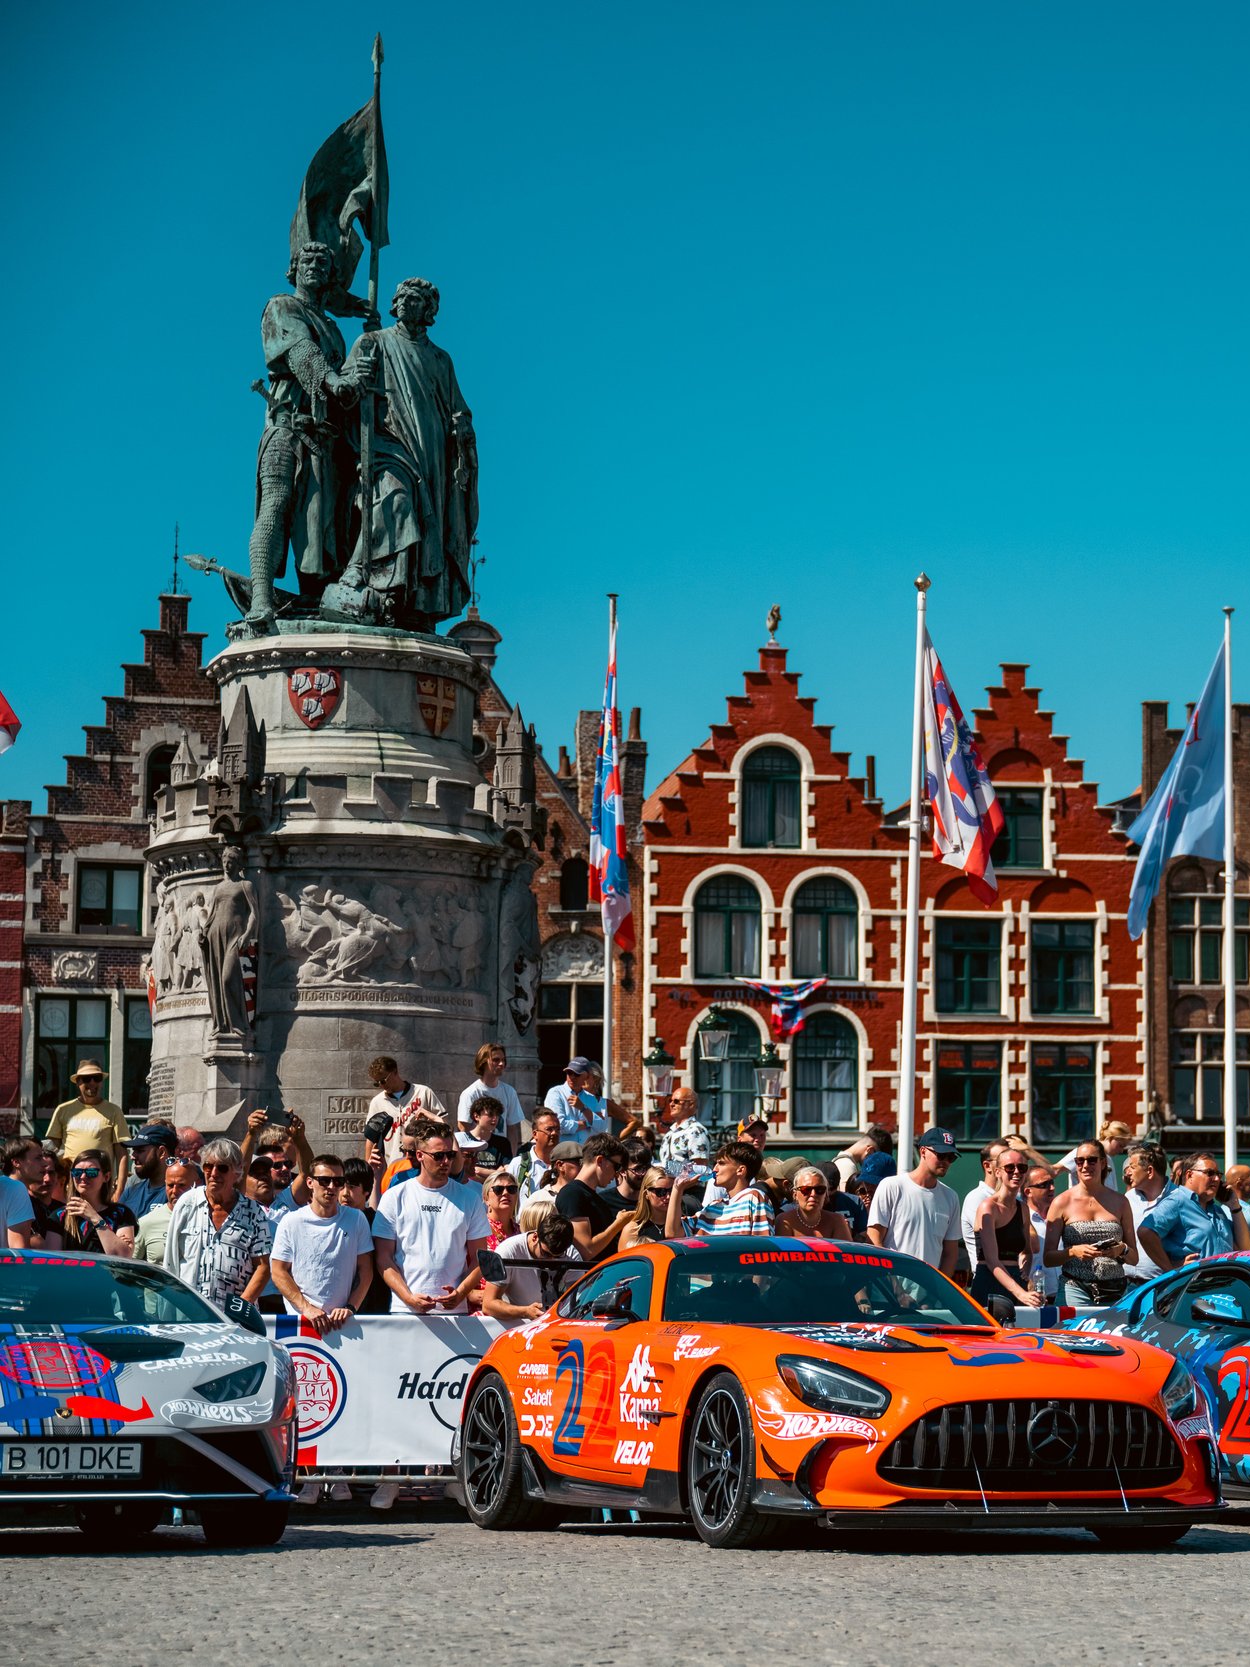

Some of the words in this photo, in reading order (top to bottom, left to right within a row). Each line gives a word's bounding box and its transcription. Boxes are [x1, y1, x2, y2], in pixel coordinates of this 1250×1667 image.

[739, 1252, 839, 1265] GUMBALL
[842, 1253, 893, 1269] 3000
[138, 1352, 249, 1370] CARRERA
[518, 1363, 549, 1376] CARRERA
[398, 1373, 469, 1400] Hard
[619, 1393, 660, 1430] Kappa
[8, 1446, 26, 1470] B
[37, 1446, 70, 1470] 101
[79, 1446, 134, 1470] DKE
